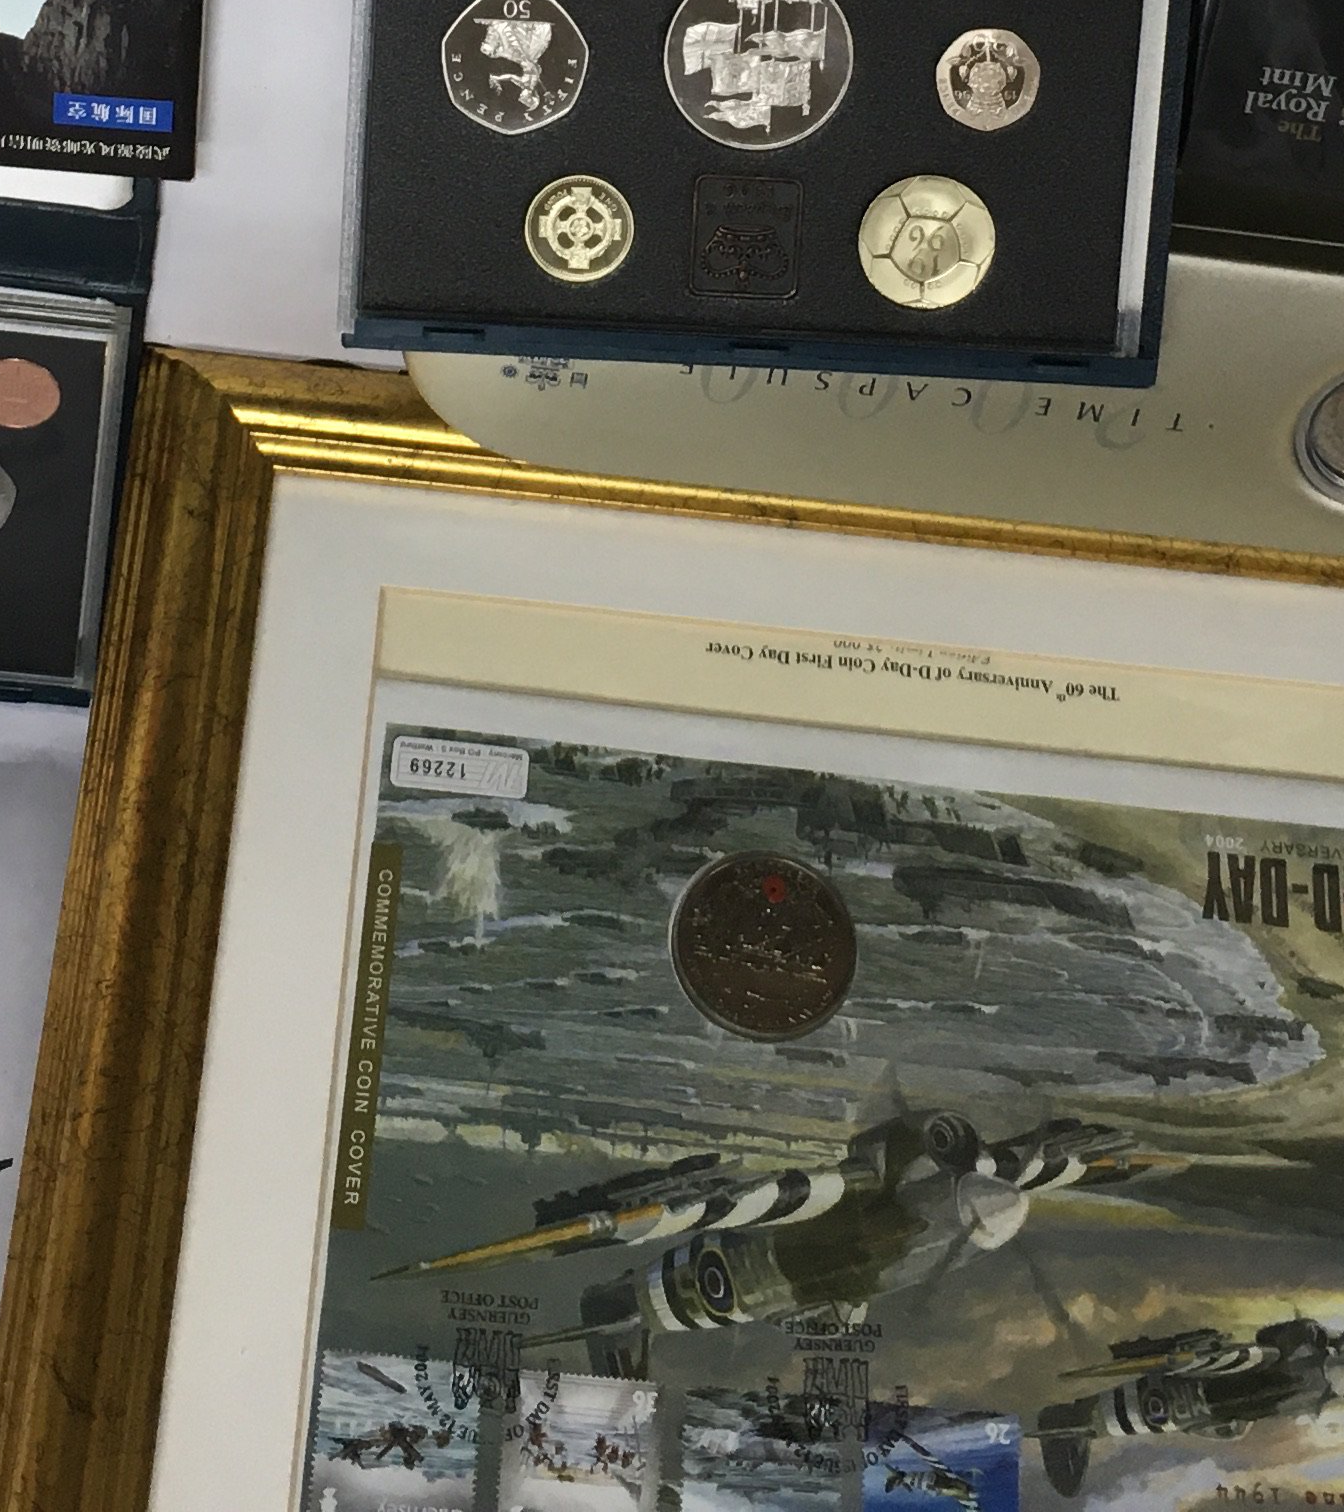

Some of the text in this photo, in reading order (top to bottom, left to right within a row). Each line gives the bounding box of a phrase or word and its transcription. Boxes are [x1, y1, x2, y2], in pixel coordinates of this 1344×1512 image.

[449, 51, 578, 123] FIFTY PENCE
[1259, 66, 1337, 97] Mint
[66, 100, 157, 127] 国际航空
[1243, 89, 1330, 122] Royal
[1277, 120, 1321, 143] The
[908, 224, 945, 251] 96
[1032, 395, 1187, 435] TIME
[704, 641, 754, 661] Cover
[758, 644, 791, 666] Day
[794, 650, 833, 670] First
[837, 654, 876, 674] Coin
[880, 656, 932, 681] D-Day
[934, 665, 952, 682] of
[955, 666, 1053, 695] Anniversary
[1055, 681, 1084, 703] 60th
[1088, 683, 1120, 702] The
[409, 758, 466, 780] 12269
[1204, 834, 1244, 850] 2004
[1201, 850, 1340, 934] D-DAY
[344, 868, 393, 1205] COMMEMORATIVE COIN COVER
[440, 1290, 538, 1310] POST OFFICE
[447, 1307, 531, 1324] GUERNSEY
[793, 1338, 876, 1353] GUERNSEY
[984, 1422, 1011, 1445] 26
[1215, 1482, 1280, 1506] 1944
